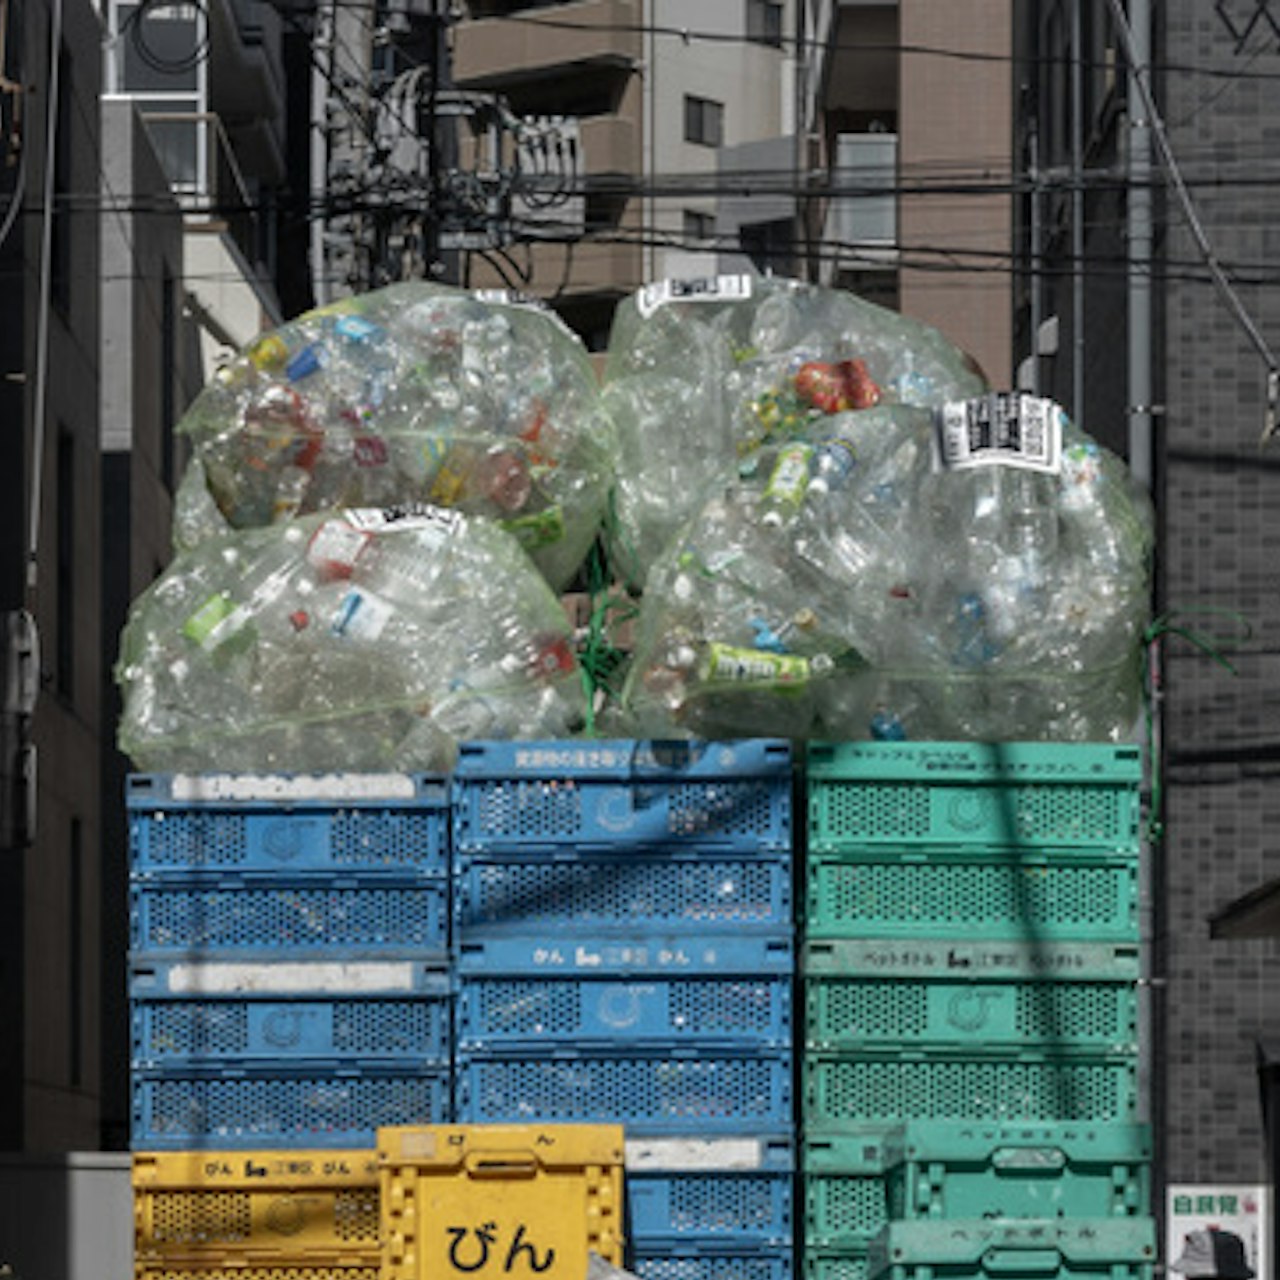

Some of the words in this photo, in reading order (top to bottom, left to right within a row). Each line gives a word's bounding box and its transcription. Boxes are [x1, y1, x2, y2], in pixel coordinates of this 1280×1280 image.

[1173, 1193, 1239, 1216] 自民党
[445, 1221, 556, 1273] びん
